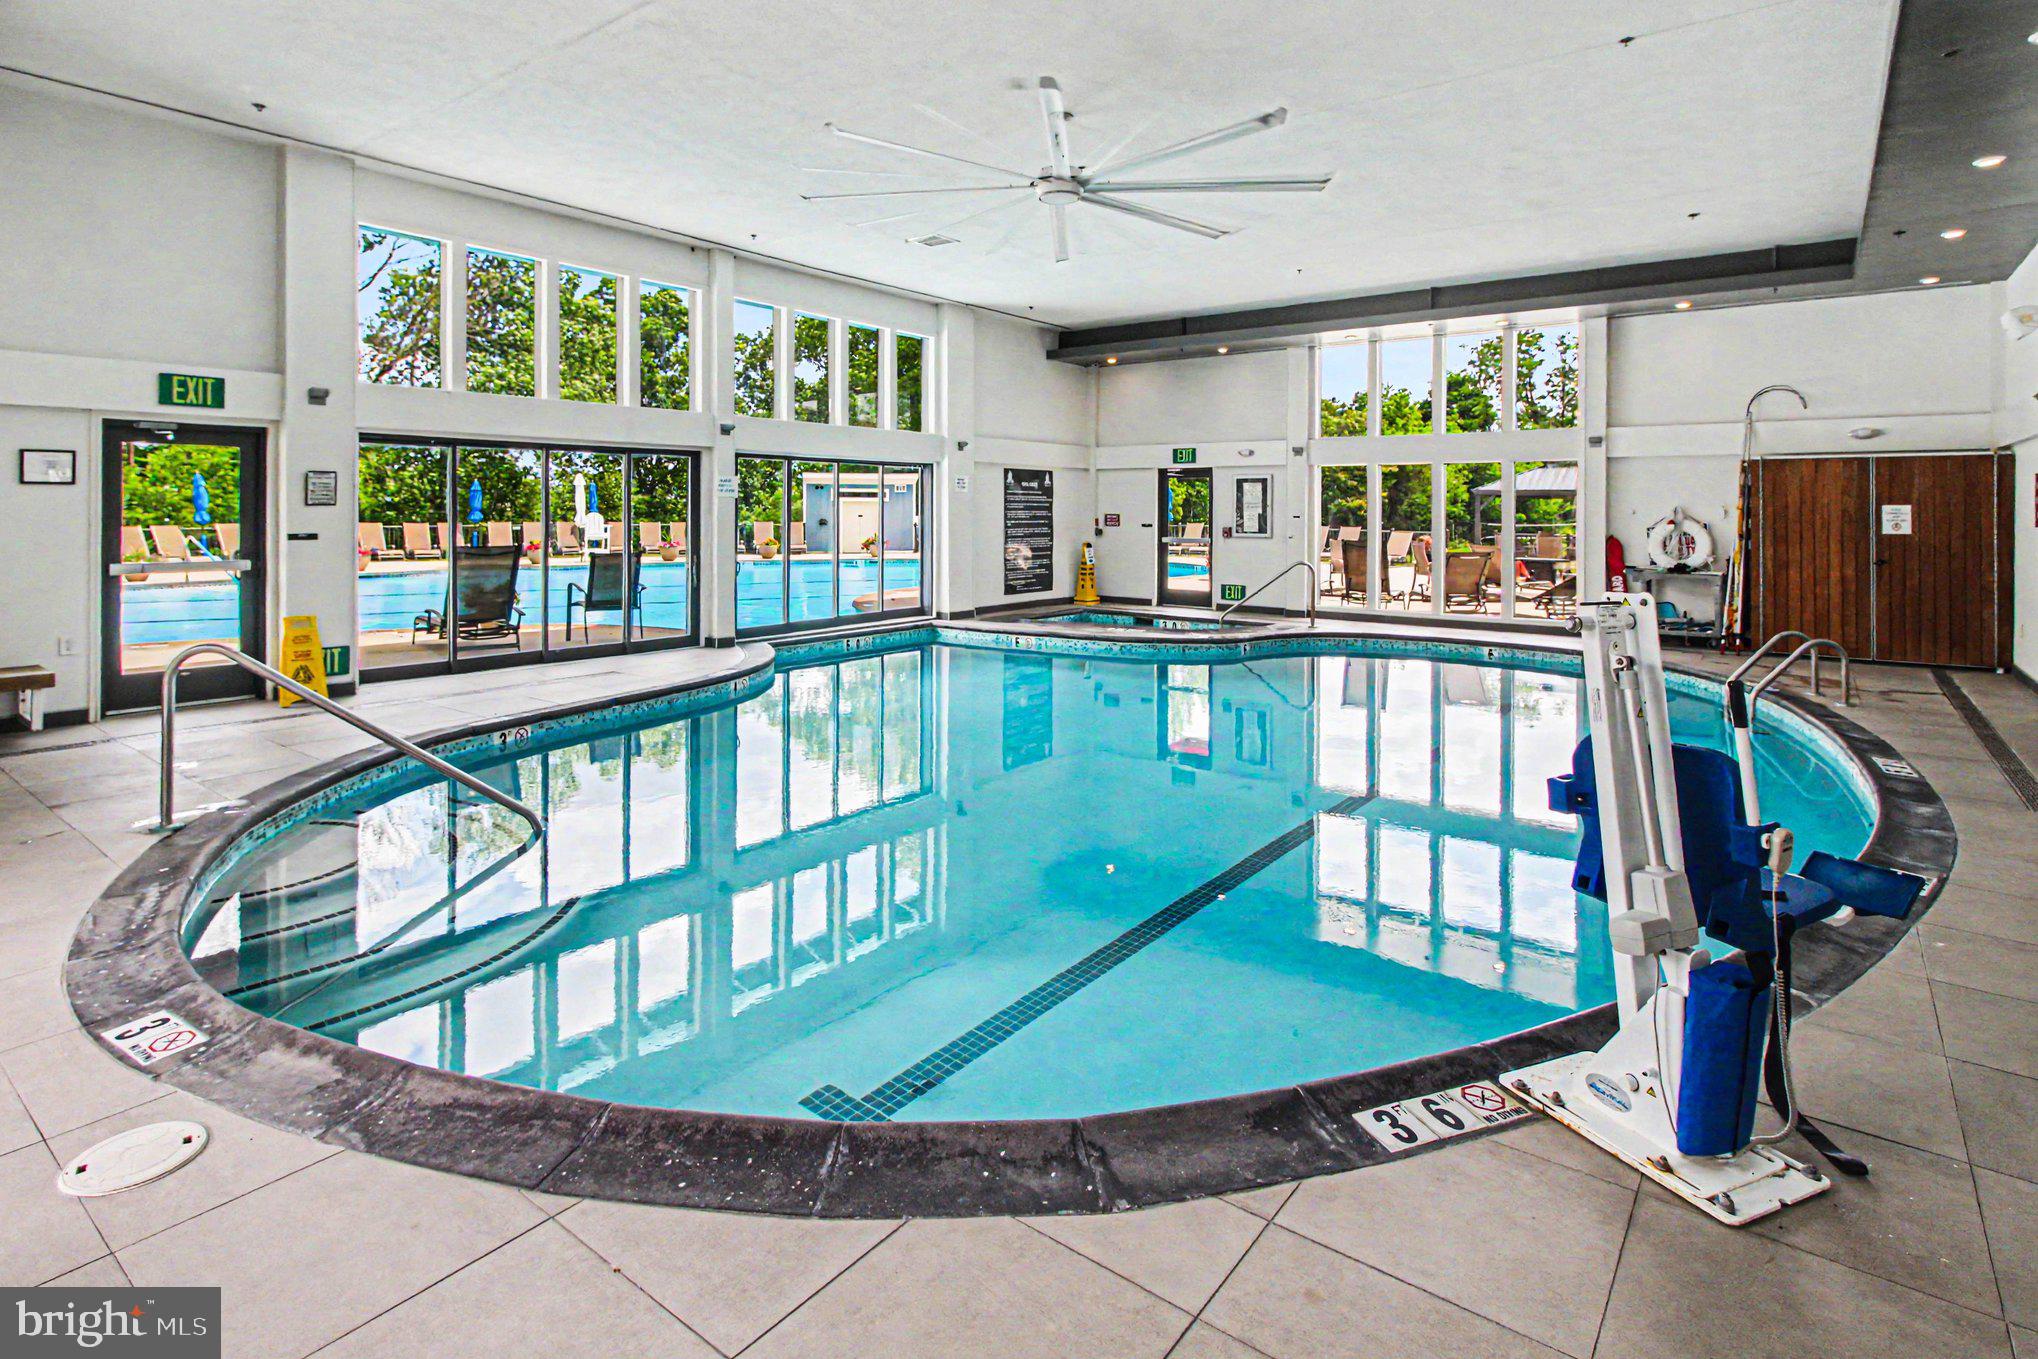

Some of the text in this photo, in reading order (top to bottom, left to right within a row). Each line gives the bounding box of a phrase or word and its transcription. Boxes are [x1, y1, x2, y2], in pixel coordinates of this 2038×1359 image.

[172, 374, 216, 406] EXIT
[1177, 448, 1193, 463] EXIT
[1225, 585, 1243, 600] EXIT
[1611, 575, 1625, 592] ARD
[322, 648, 342, 673] IT
[1372, 1109, 1419, 1145] 3
[1421, 1098, 1465, 1131] 6
[1483, 1106, 1528, 1124] NO DIVING
